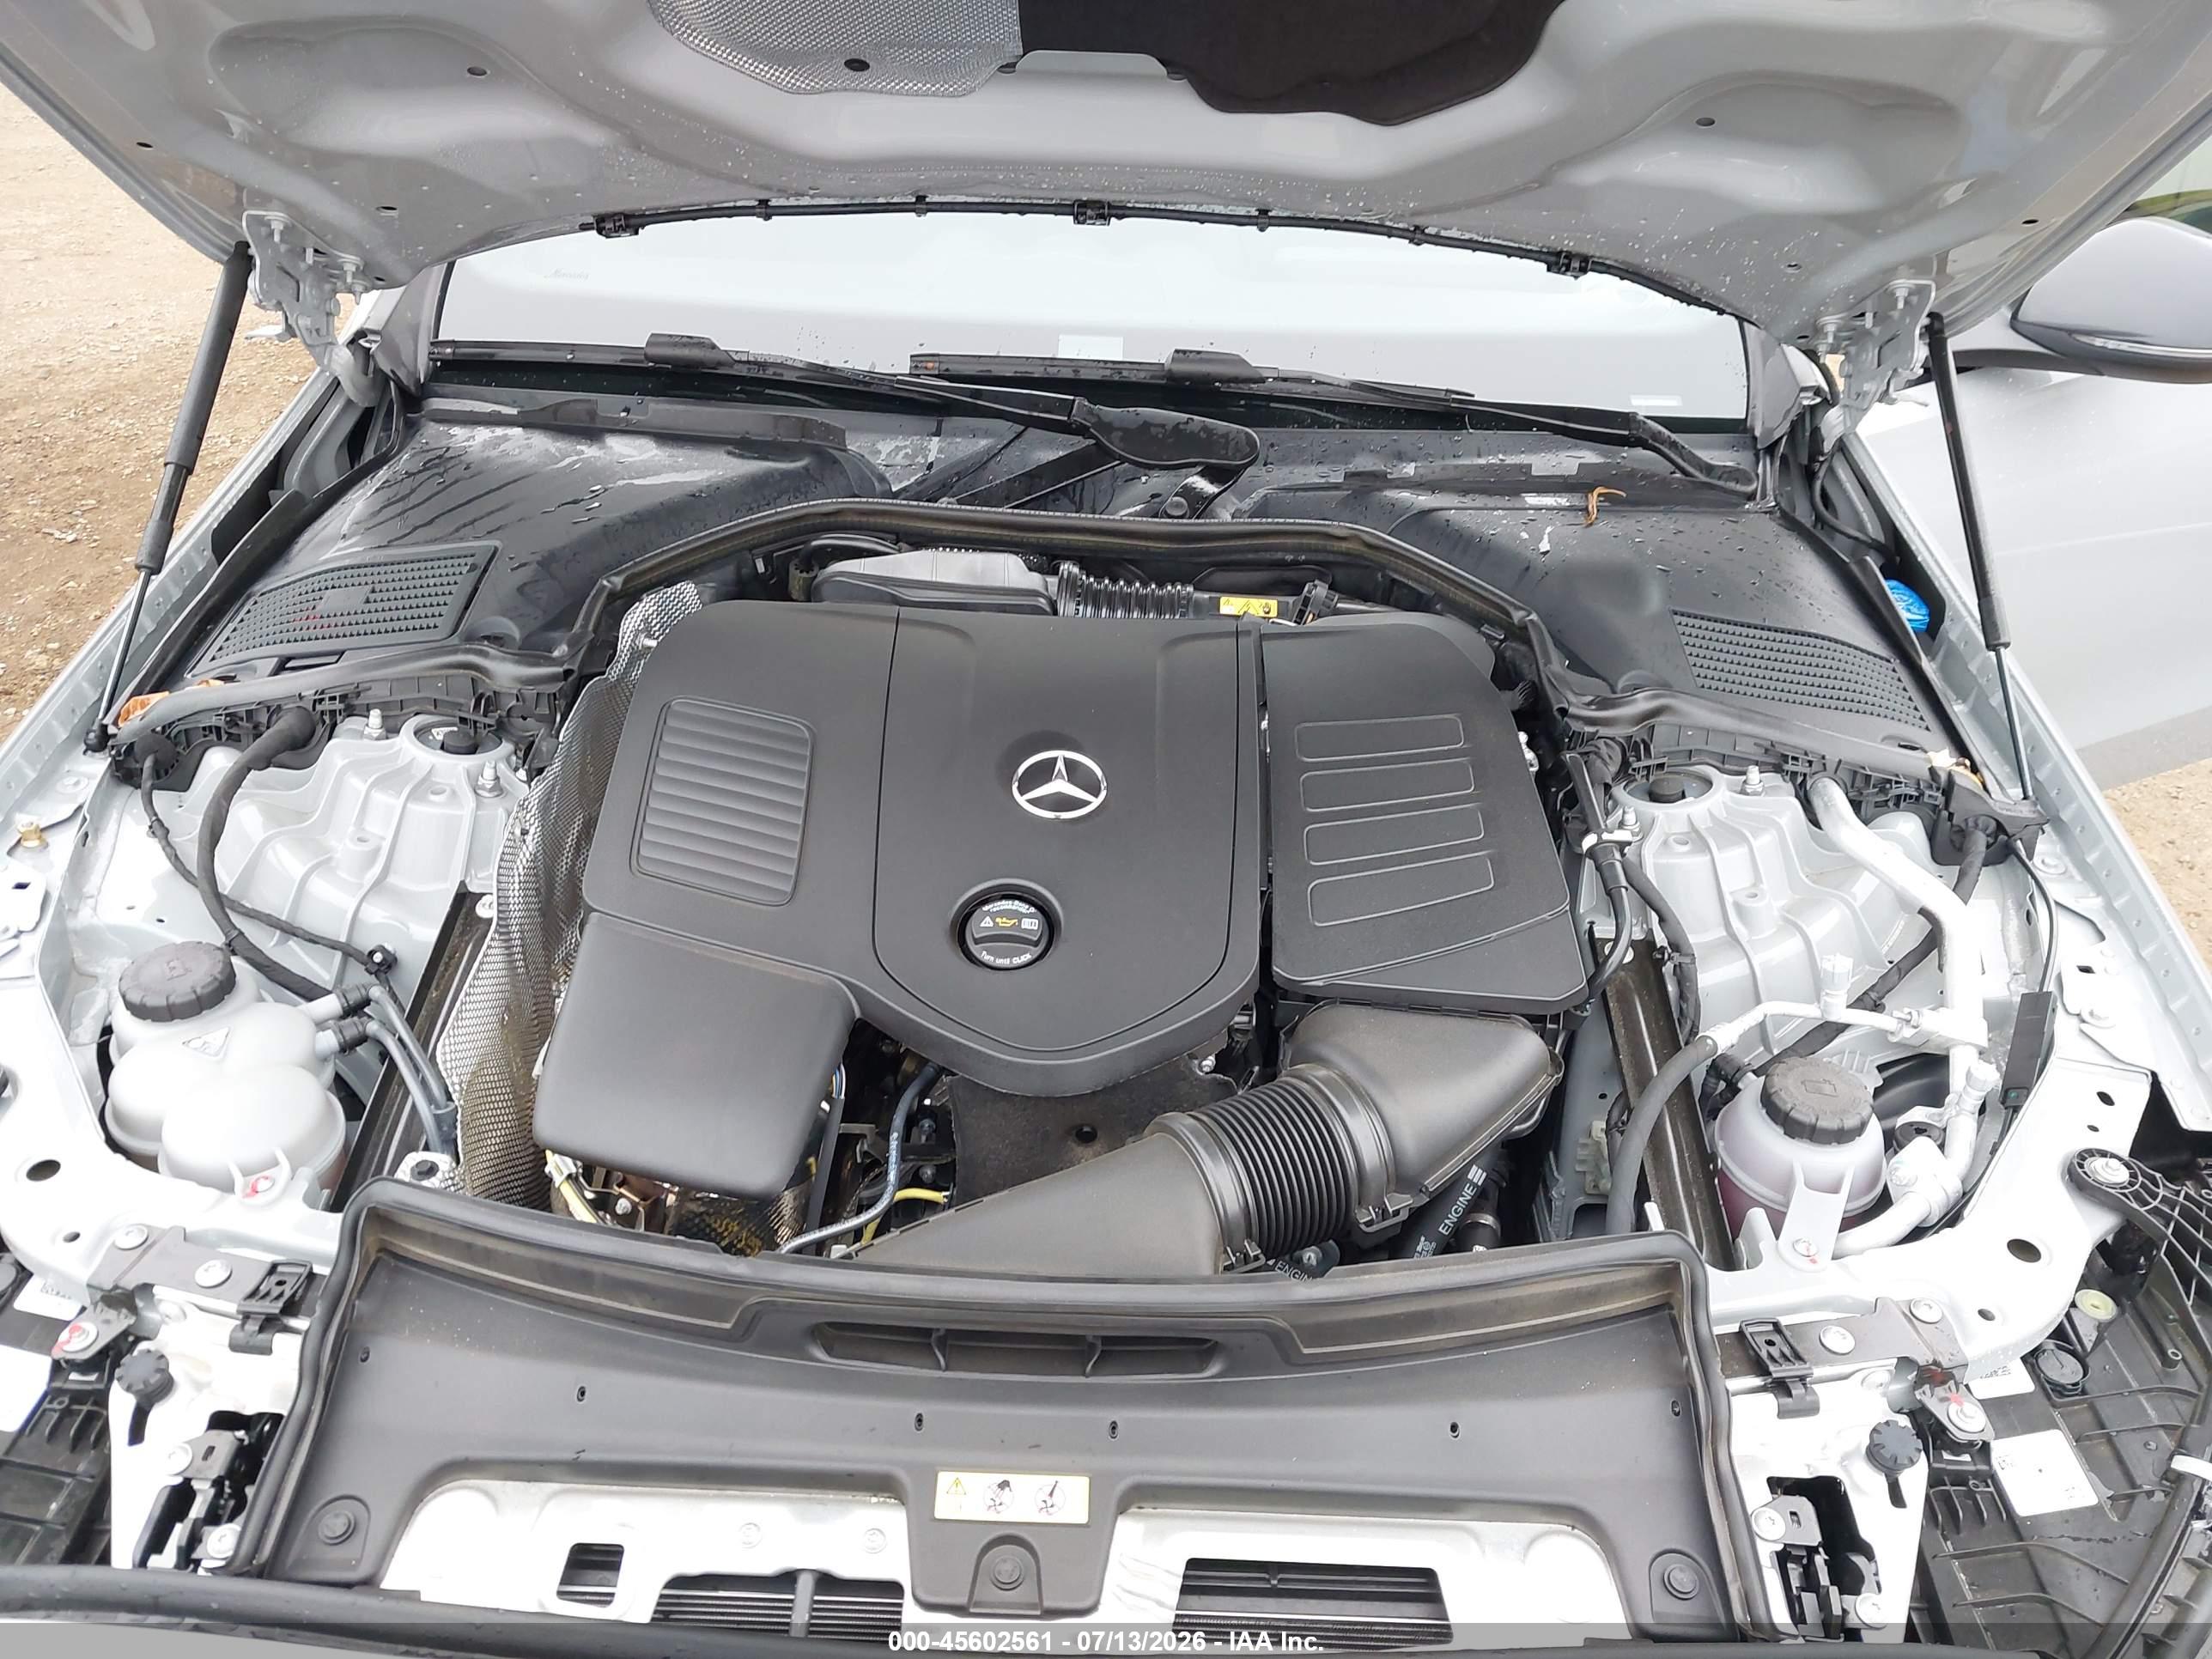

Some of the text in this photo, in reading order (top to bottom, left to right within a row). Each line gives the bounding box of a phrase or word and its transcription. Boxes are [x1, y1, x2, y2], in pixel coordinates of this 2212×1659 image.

[981, 950, 994, 963] Turn
[1438, 1183, 1478, 1236] ENGINE
[1274, 1260, 1313, 1282] ENGIN
